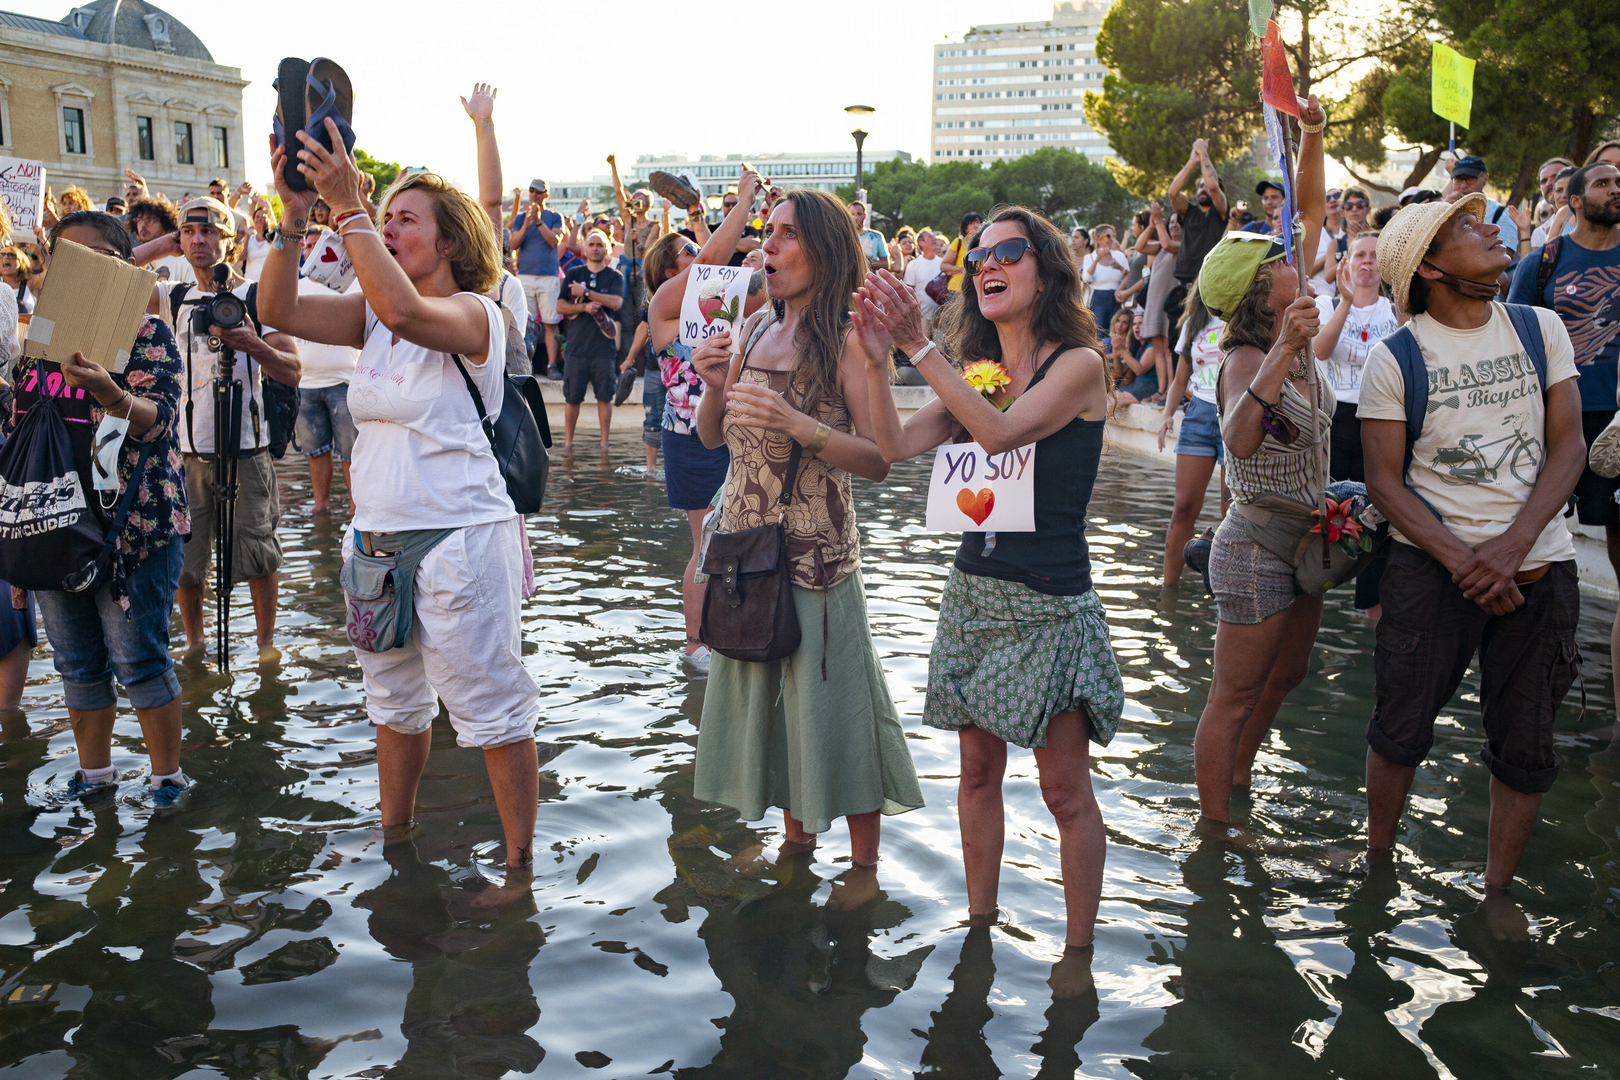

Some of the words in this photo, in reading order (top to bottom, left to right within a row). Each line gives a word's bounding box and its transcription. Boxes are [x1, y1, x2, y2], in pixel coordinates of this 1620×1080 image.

[696, 266, 711, 281] YO
[685, 320, 698, 339] YO
[1466, 379, 1538, 408] Bicycles
[943, 451, 976, 484] YO
[984, 448, 1031, 480] SOY
